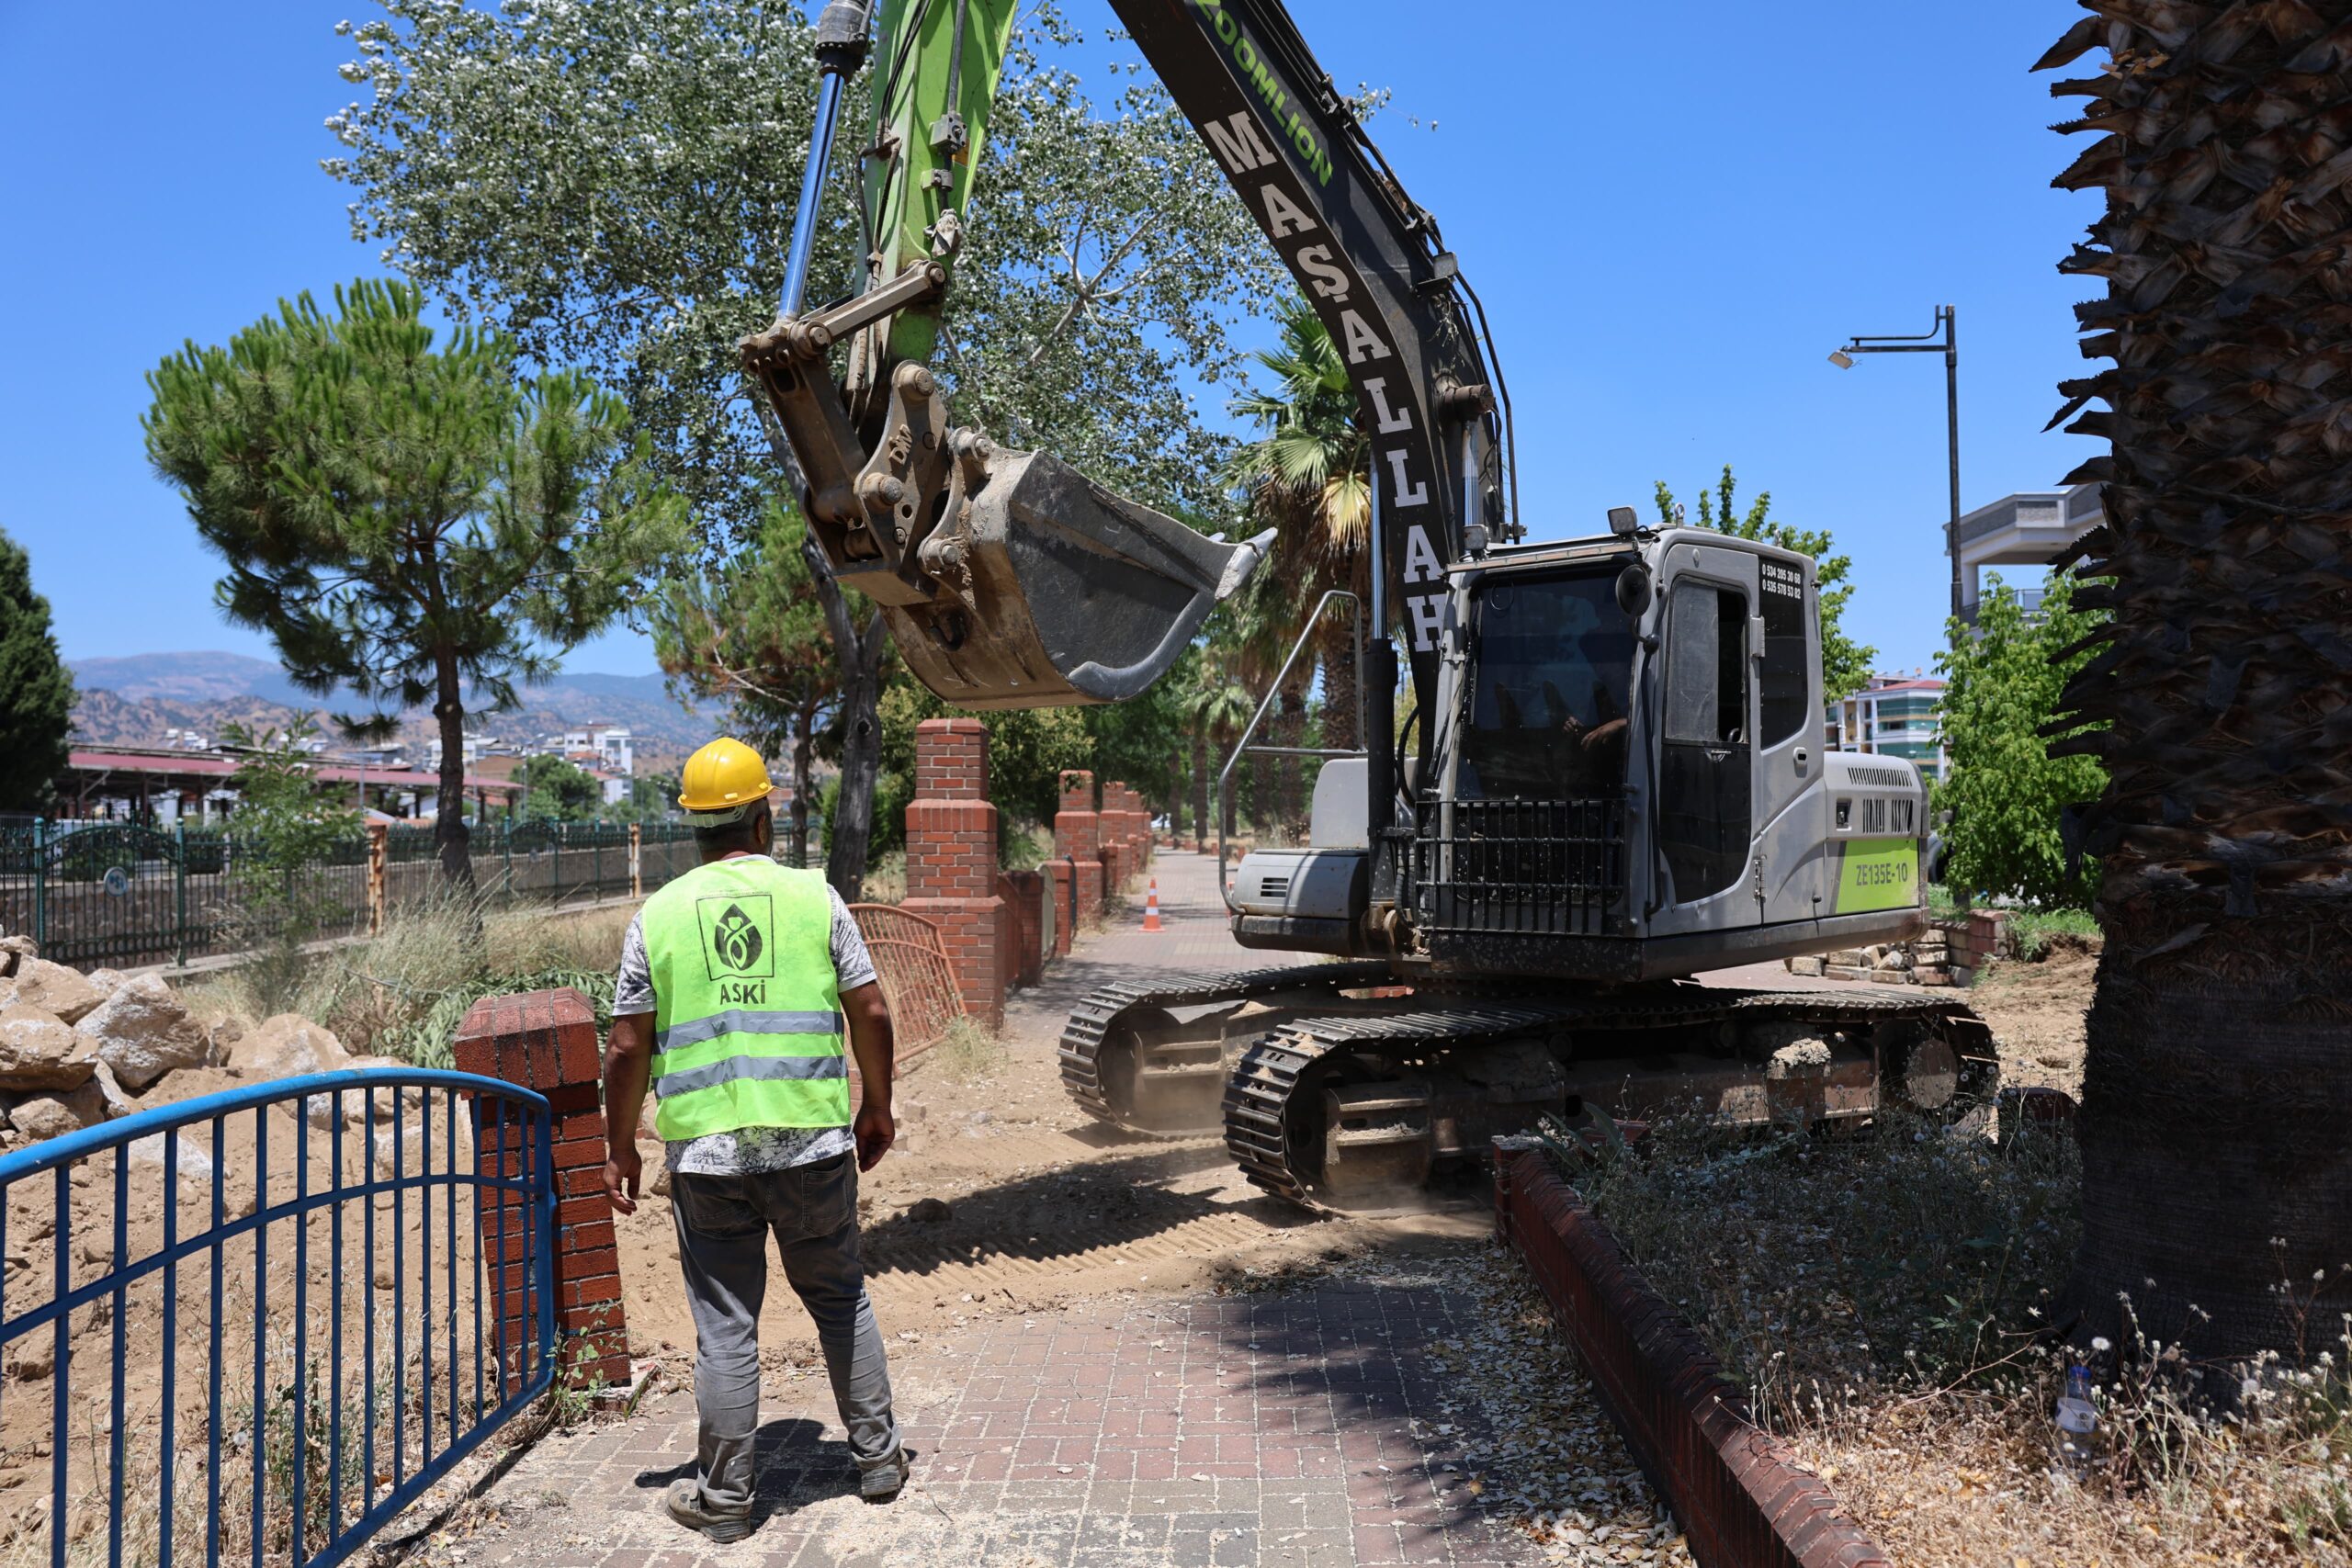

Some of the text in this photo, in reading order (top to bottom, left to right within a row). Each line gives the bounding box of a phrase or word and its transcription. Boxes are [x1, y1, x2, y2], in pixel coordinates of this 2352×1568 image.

[1195, 0, 1333, 187] ZOOMLION
[1761, 563, 1767, 576] 0
[1767, 565, 1777, 578] 534
[1777, 567, 1787, 581] 205
[1787, 570, 1794, 583] 30
[1761, 579, 1767, 591] 0
[1767, 580, 1777, 593] 535
[1777, 582, 1787, 596] 578
[1787, 585, 1794, 598] 53
[1856, 863, 1908, 886] ZE135E-10
[719, 979, 766, 1006] ASKİ
